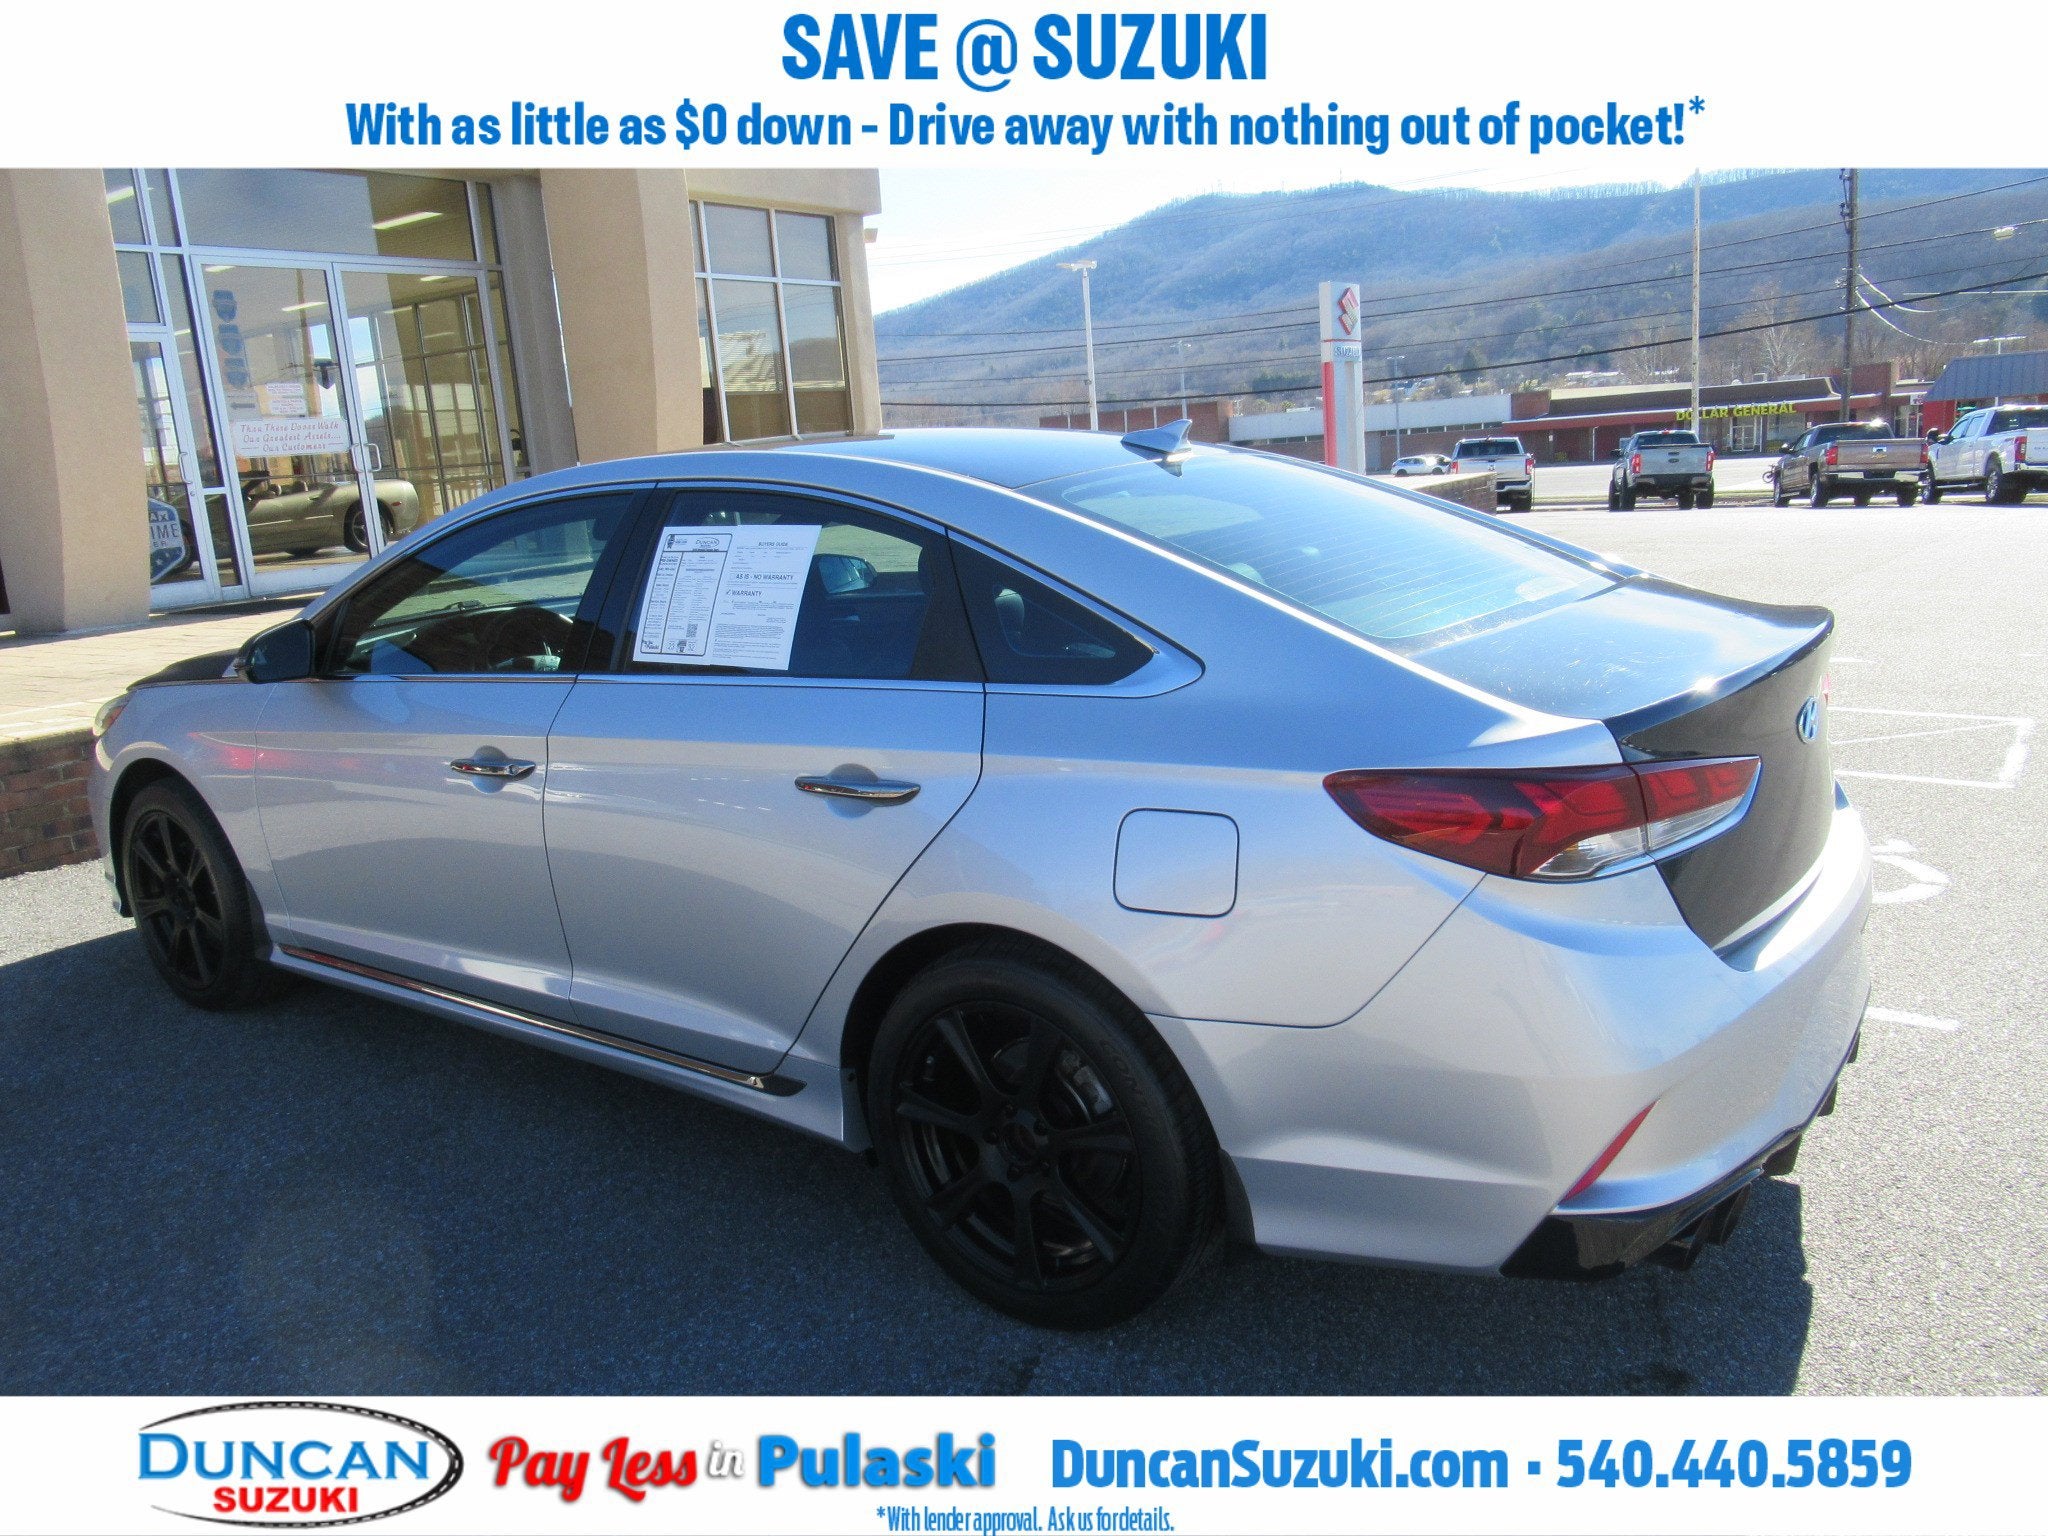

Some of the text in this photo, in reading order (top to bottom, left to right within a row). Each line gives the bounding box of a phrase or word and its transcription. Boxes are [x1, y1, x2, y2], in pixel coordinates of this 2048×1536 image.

[1733, 403, 1797, 417] GENERAL
[265, 423, 288, 432] These
[291, 422, 316, 431] Doors
[317, 421, 339, 430] Walk
[243, 435, 260, 443] Our
[263, 433, 300, 442] Greatest
[262, 442, 326, 452] Our Customers
[151, 523, 179, 540] IME
